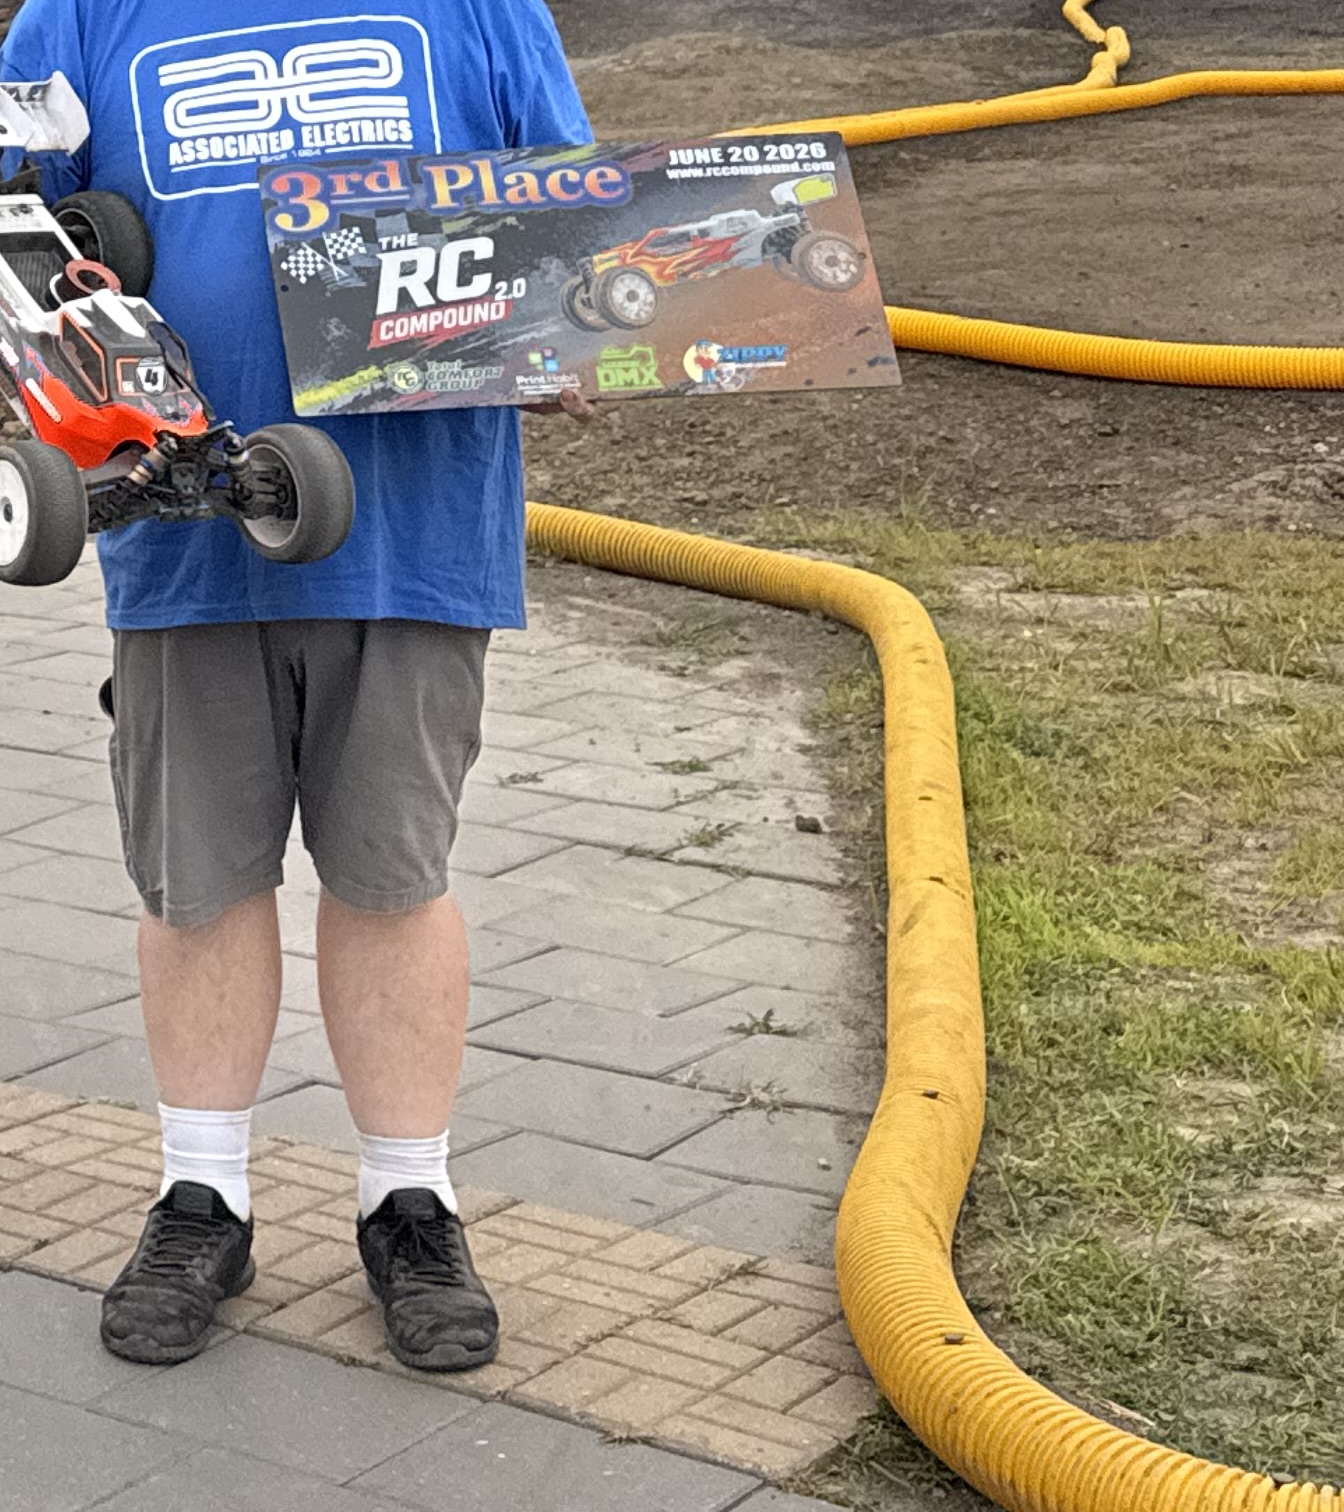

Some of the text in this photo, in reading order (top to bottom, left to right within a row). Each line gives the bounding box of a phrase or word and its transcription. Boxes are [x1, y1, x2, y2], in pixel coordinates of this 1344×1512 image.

[169, 119, 414, 166] ASSOCIATED ELECTRICS
[669, 142, 827, 166] JUNE 20 2026
[666, 161, 836, 180] www.rccompound.com
[271, 159, 625, 232] 3rd Place
[378, 232, 419, 250] THE
[375, 236, 495, 316] RC
[494, 277, 527, 301] 2.0
[380, 301, 506, 341] COMPOUND
[144, 368, 160, 386] 4
[426, 366, 504, 382] COMFORT
[516, 375, 545, 385] Print
[598, 366, 661, 386] DMX
[426, 378, 485, 391] GROUP
